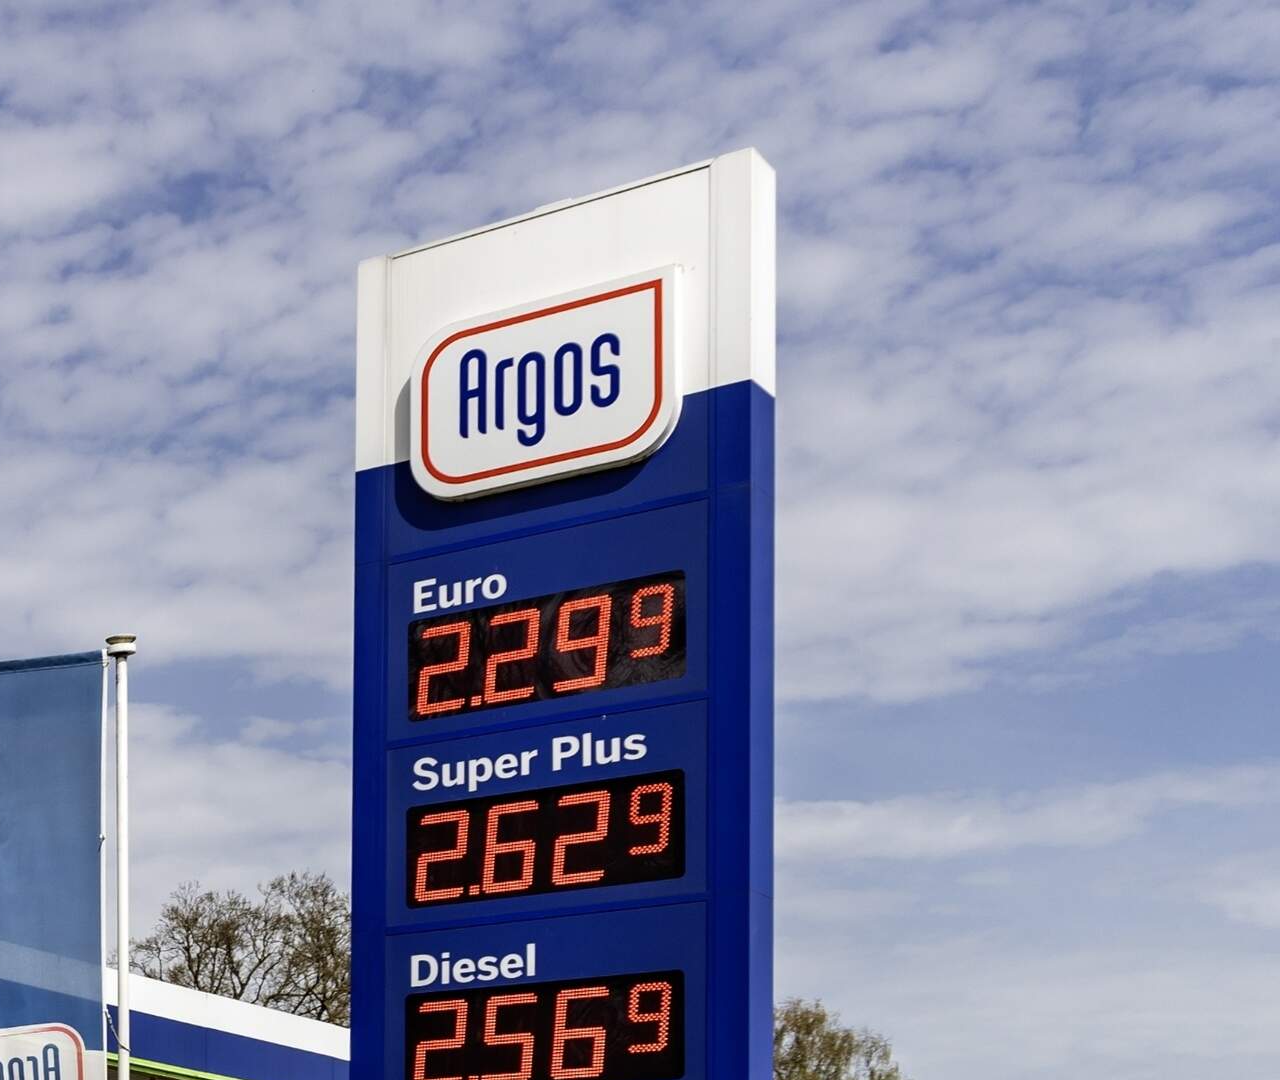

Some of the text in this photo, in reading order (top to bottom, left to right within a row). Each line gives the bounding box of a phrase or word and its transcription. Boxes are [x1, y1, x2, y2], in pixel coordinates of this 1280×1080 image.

[459, 332, 621, 447] Argos
[412, 573, 508, 614] Euro
[412, 731, 648, 793] Super Plus
[410, 943, 536, 988] Diesel
